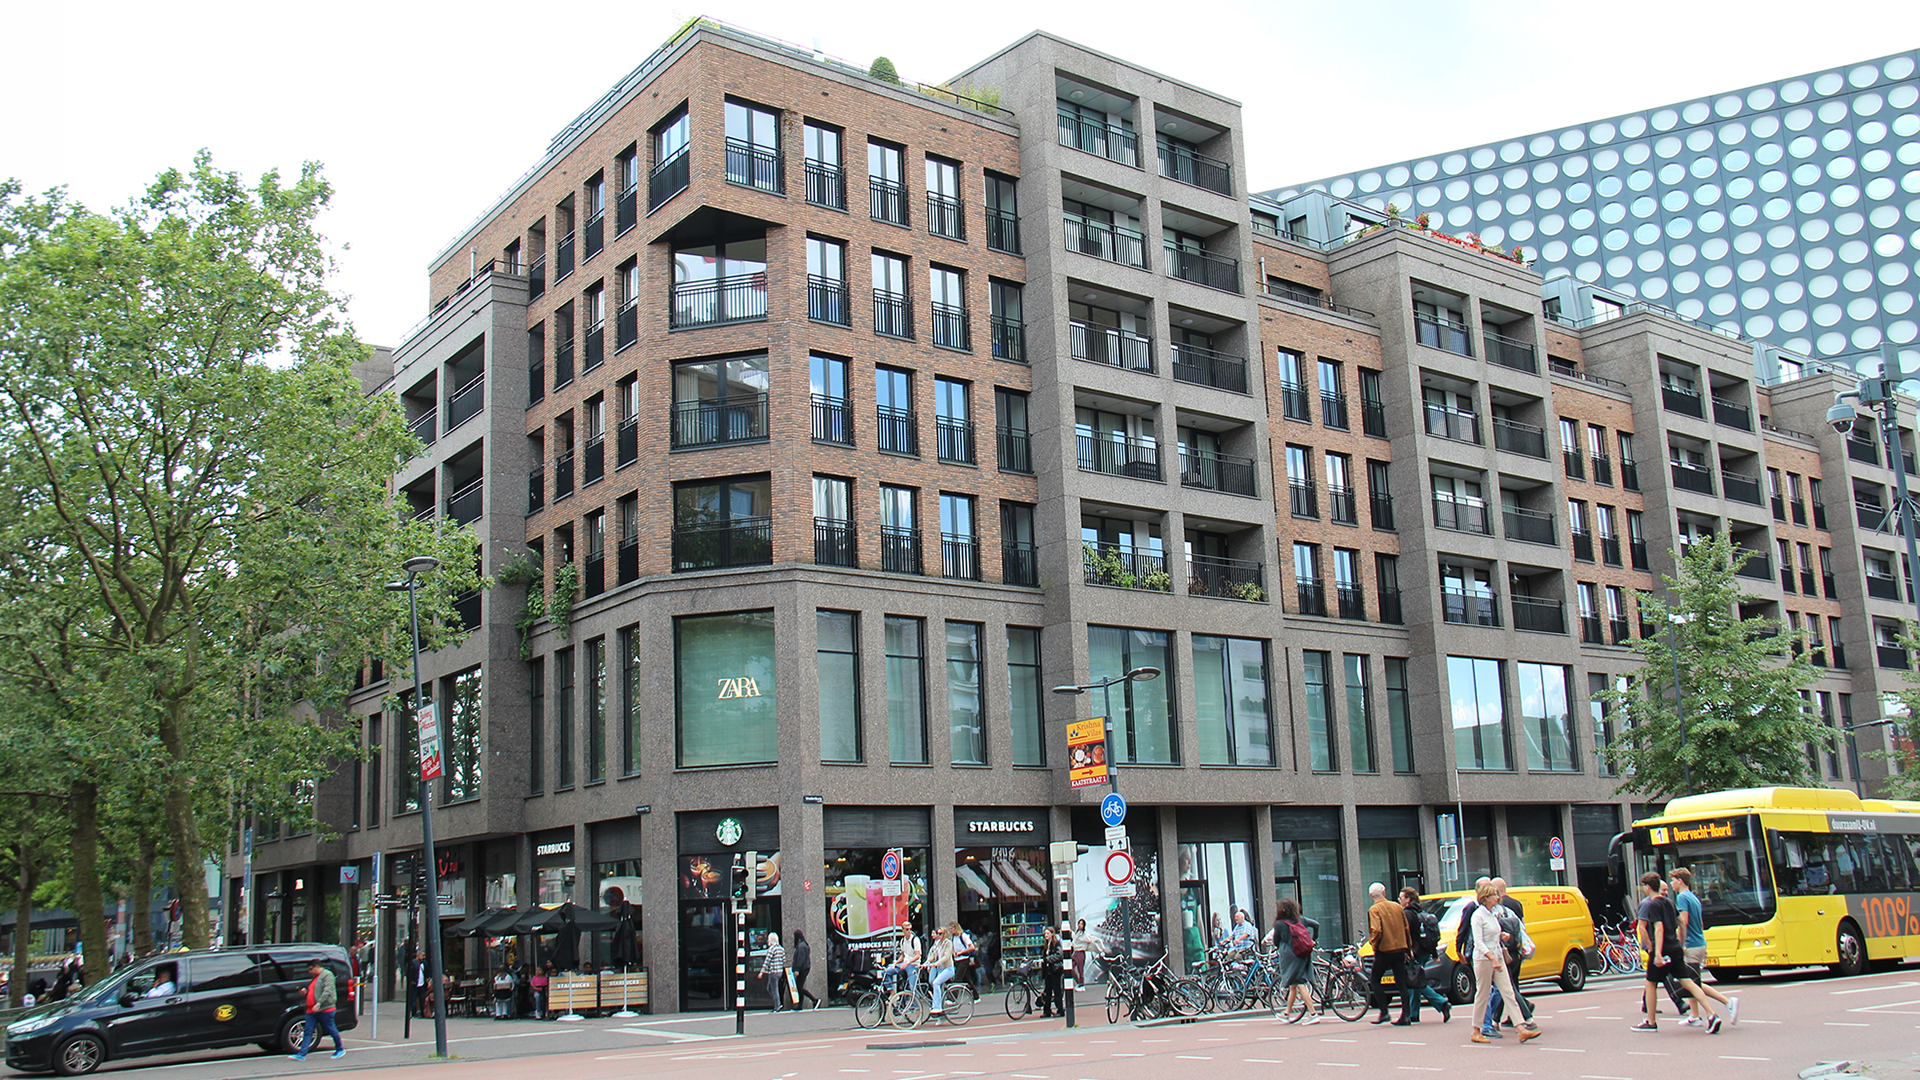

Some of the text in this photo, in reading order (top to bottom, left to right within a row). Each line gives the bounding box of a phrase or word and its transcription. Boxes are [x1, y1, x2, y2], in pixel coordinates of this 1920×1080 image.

[717, 677, 762, 699] ZARA
[1076, 721, 1100, 731] Krishna
[1071, 776, 1103, 786] KAATSTRAAT
[969, 820, 1035, 832] STARBUCKS
[1656, 821, 1732, 843] 1 Overvecht-Noord
[537, 841, 570, 855] STARBUCKS
[1540, 894, 1569, 905] DHL
[1861, 896, 1920, 938] 100%
[1746, 927, 1765, 935] 4609
